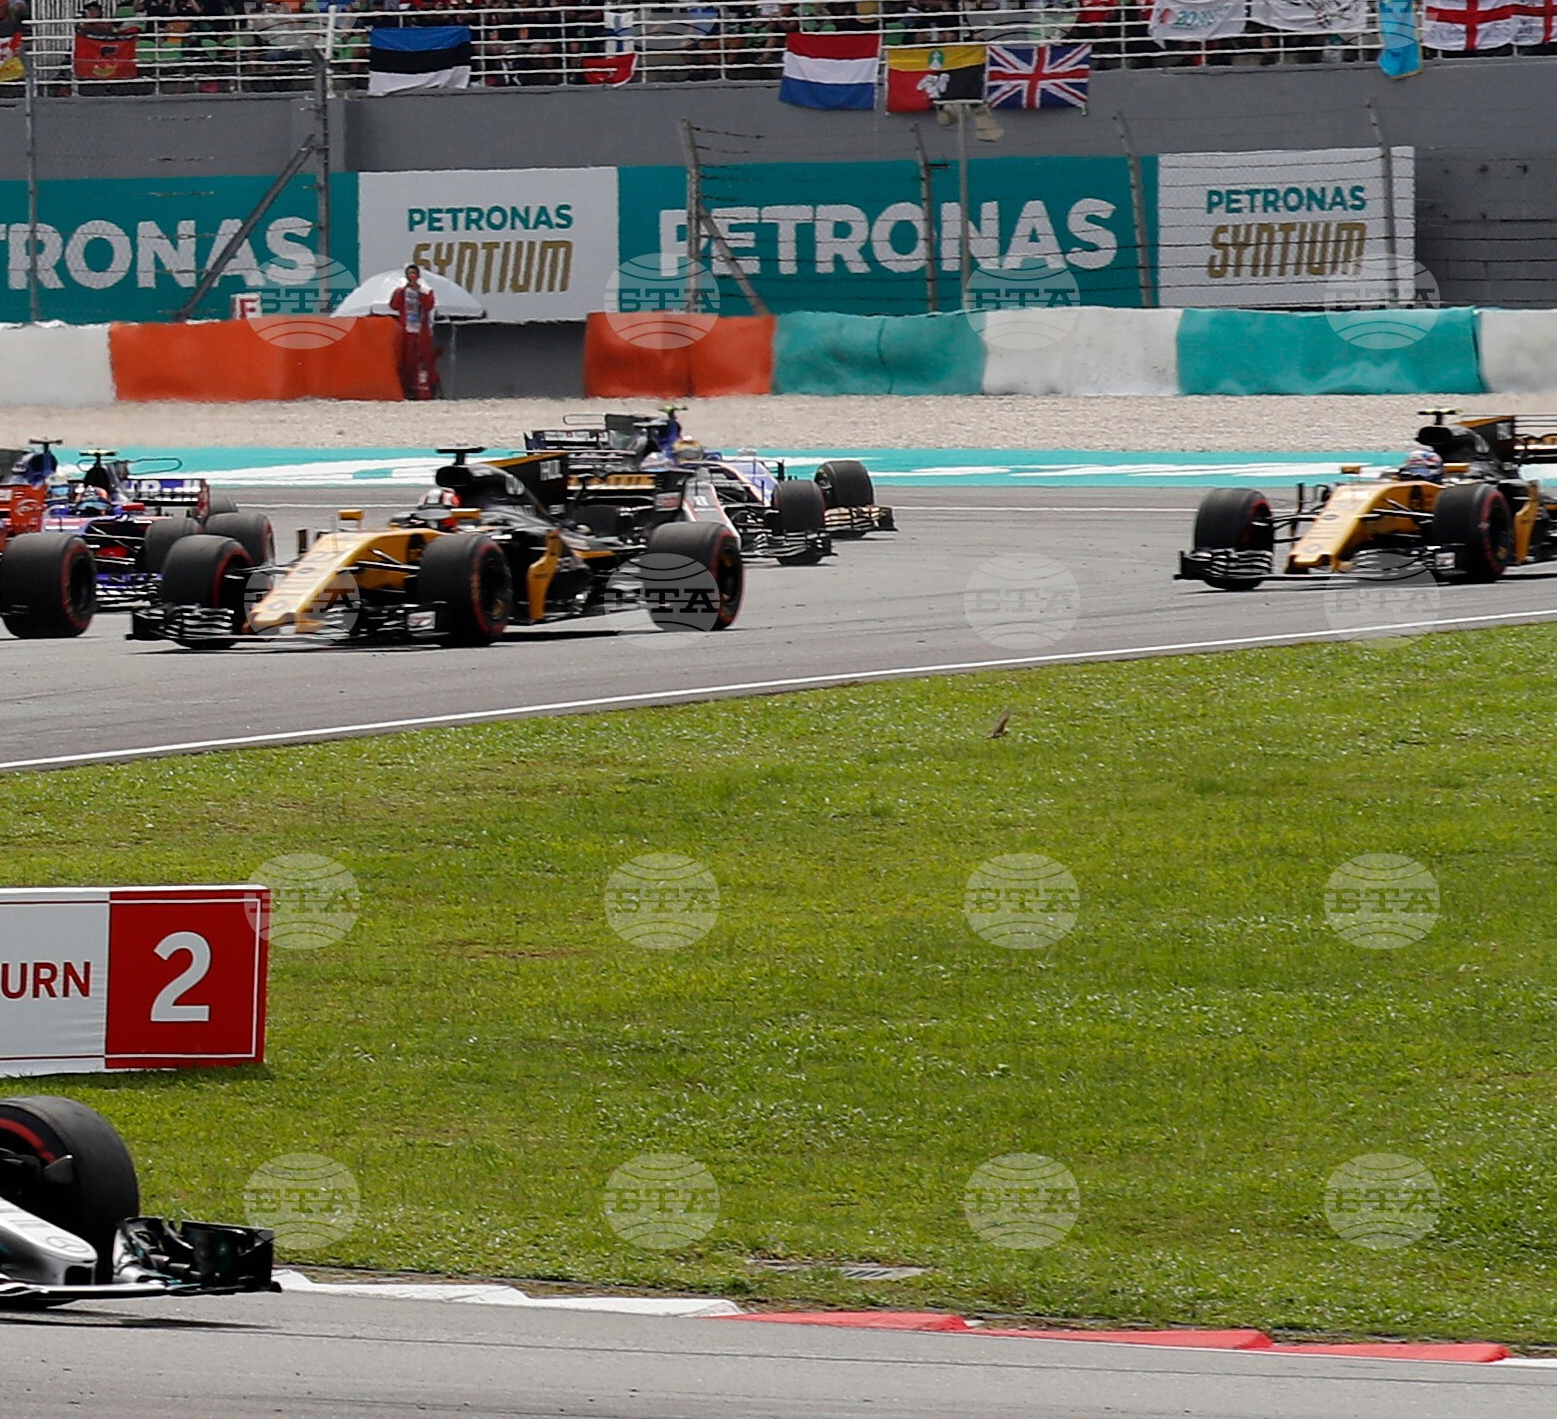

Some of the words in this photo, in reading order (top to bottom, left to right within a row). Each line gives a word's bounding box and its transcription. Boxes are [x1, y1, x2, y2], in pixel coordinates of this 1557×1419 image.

[407, 203, 574, 232] PETRONAS
[1207, 185, 1368, 214] PETRONAS
[660, 198, 1118, 277] PETRONAS
[1207, 222, 1367, 279] SYNTIUM
[149, 930, 212, 1022] 2
